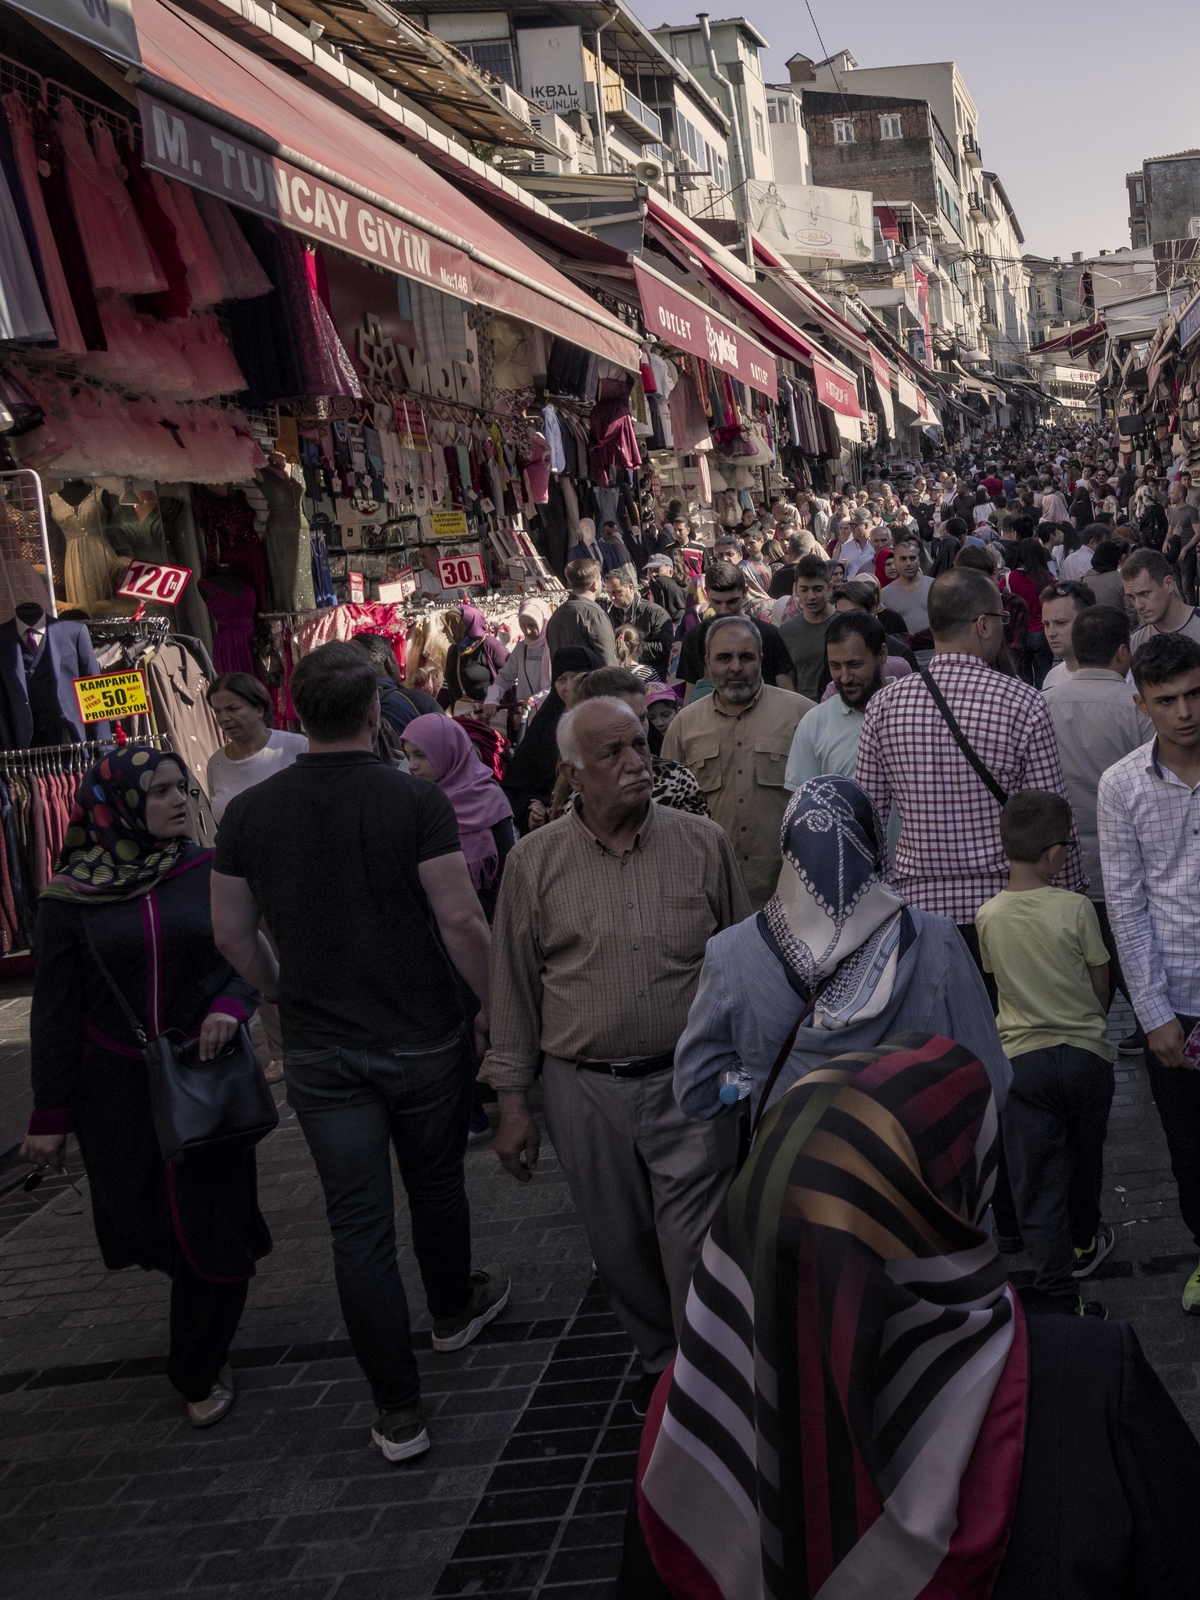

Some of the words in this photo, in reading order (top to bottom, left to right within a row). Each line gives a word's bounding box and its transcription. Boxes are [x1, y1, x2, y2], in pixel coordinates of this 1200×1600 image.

[152, 105, 202, 176] M.
[210, 135, 348, 240] TUNCAY
[658, 306, 692, 340] OUTLET
[126, 564, 182, 599] 120
[442, 560, 473, 585] 30
[80, 674, 139, 692] KAMPANYA
[102, 688, 127, 708] 50
[85, 703, 147, 721] PROMOSYON
